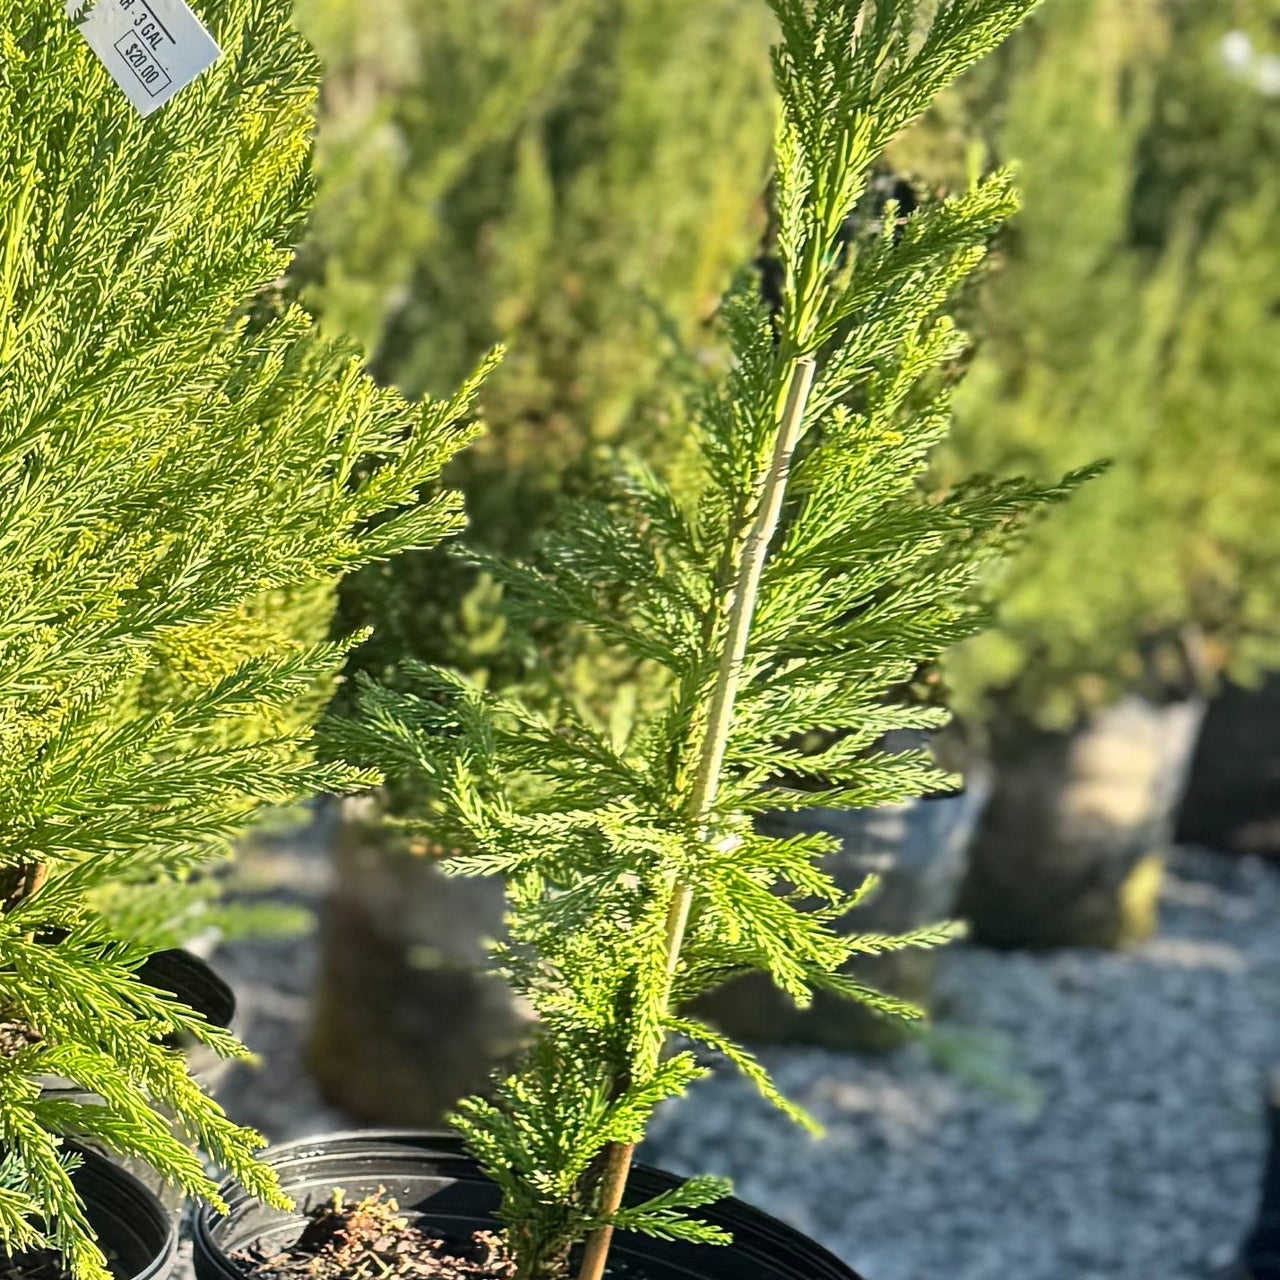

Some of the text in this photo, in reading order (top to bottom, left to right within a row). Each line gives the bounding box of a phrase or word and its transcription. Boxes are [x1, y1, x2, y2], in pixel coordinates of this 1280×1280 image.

[133, 13, 148, 27] 3
[141, 23, 163, 51] GAL
[125, 43, 160, 84] $20.00
